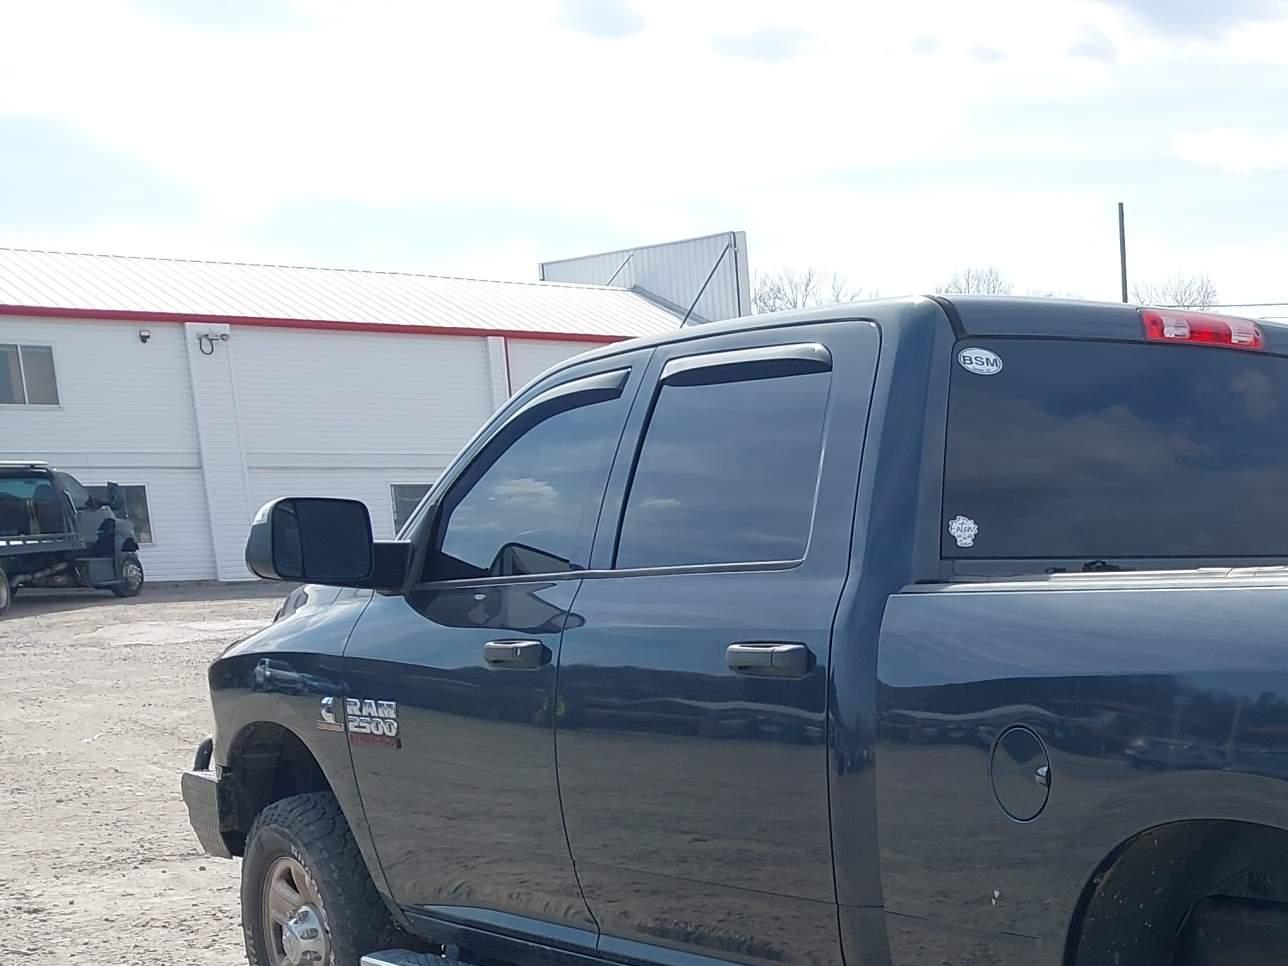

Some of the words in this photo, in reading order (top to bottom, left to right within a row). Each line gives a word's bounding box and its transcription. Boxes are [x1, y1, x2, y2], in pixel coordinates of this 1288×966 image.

[961, 355, 999, 368] BSM
[345, 697, 397, 719] RAM
[347, 715, 398, 737] 2500
